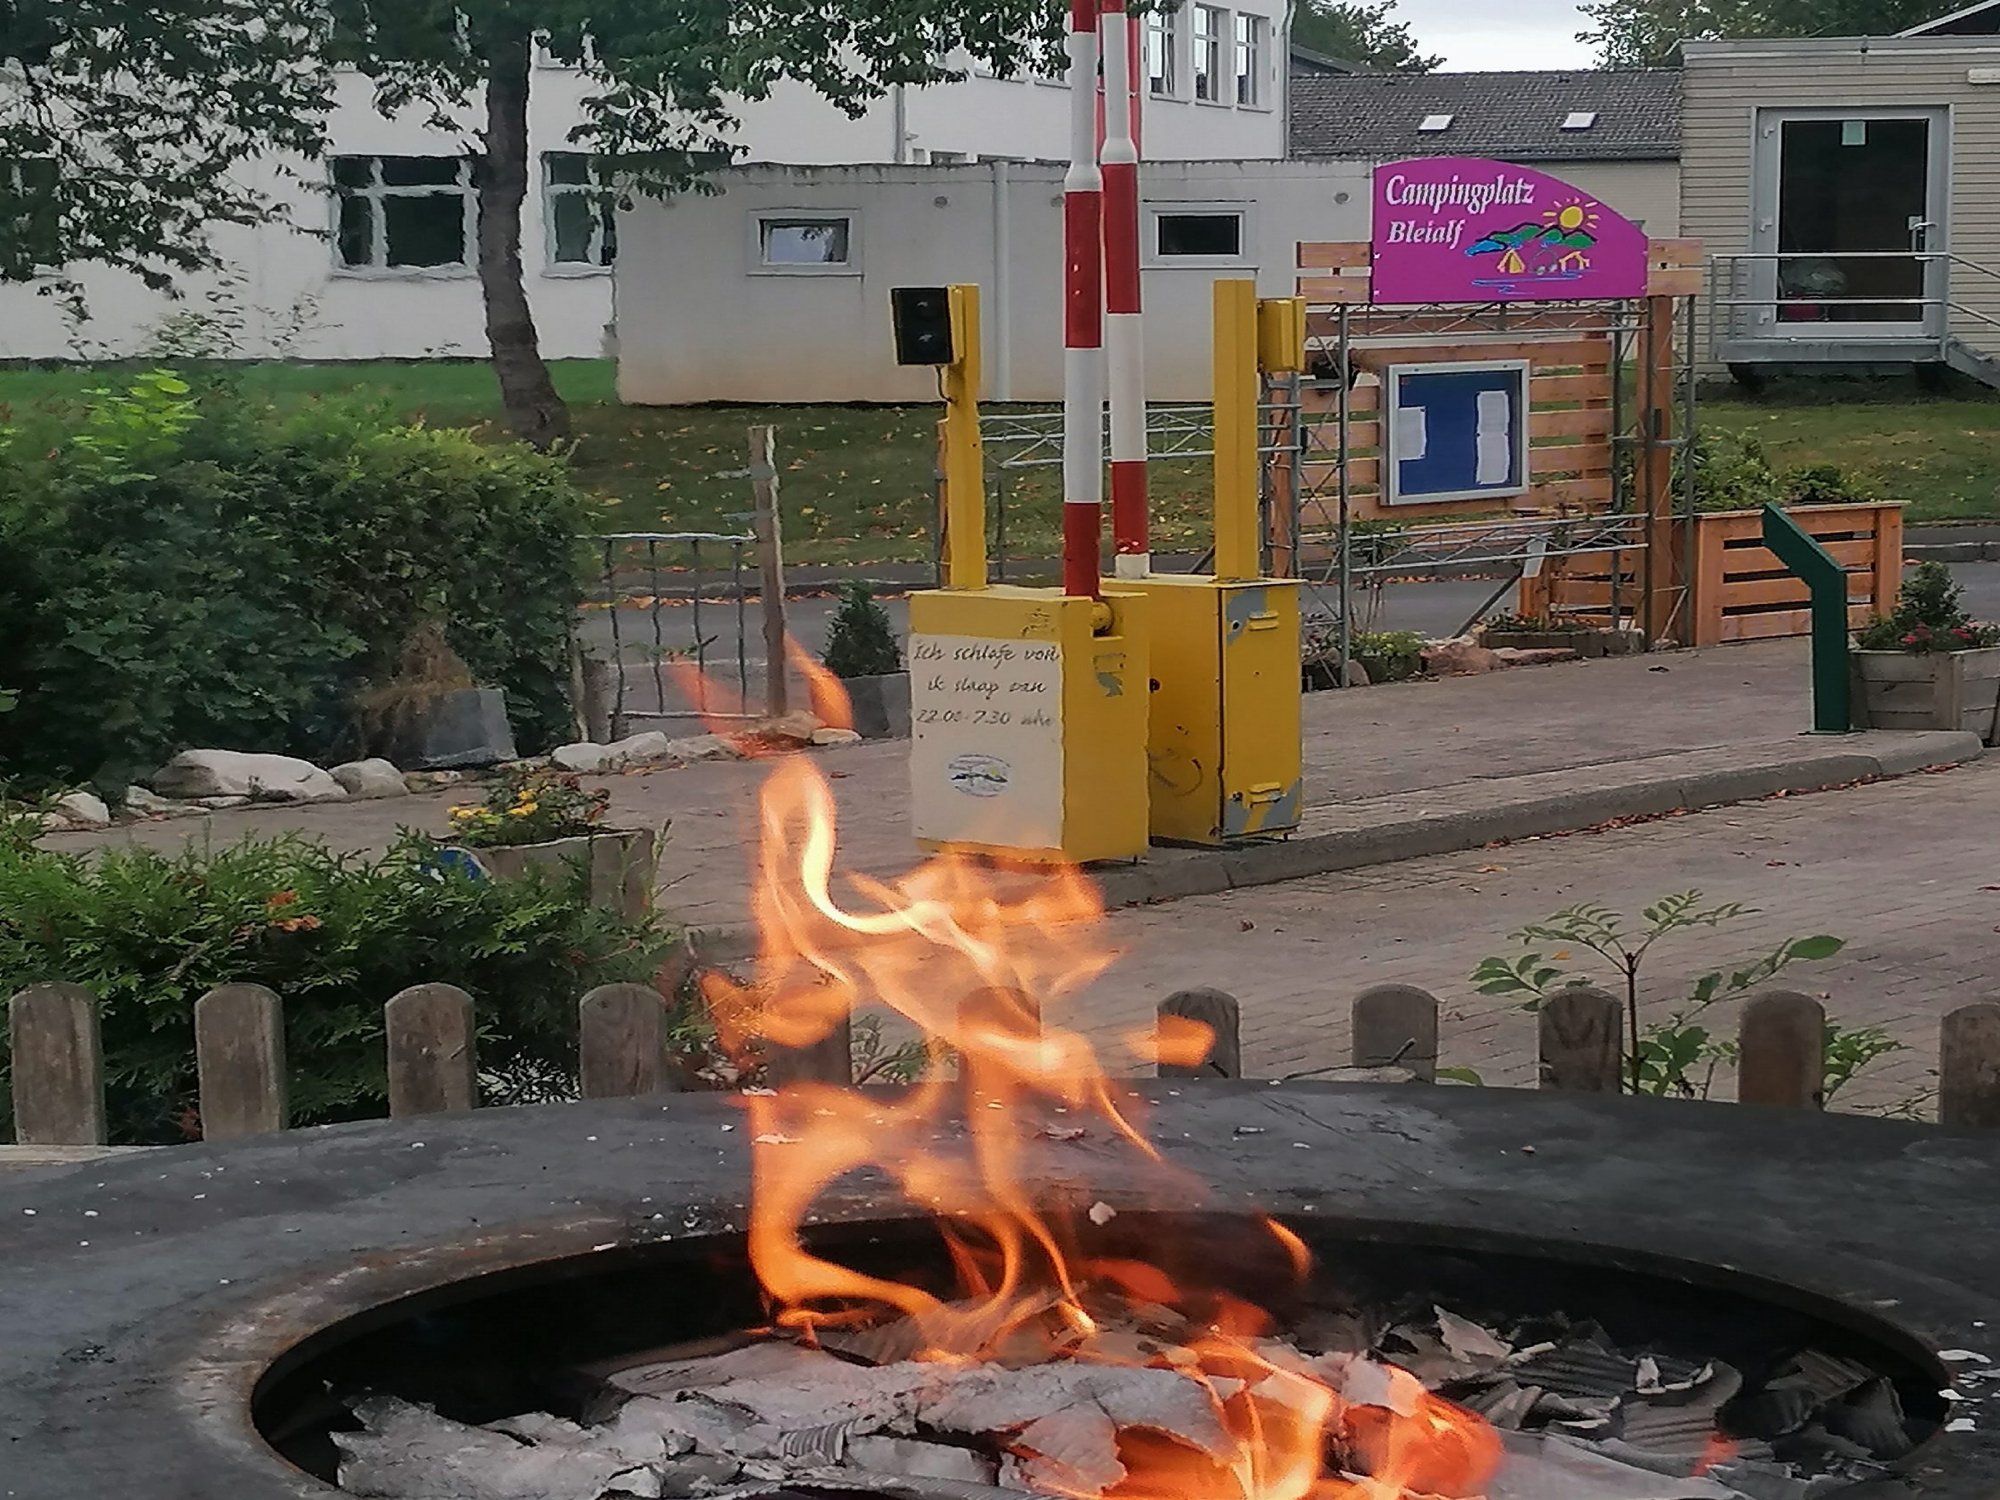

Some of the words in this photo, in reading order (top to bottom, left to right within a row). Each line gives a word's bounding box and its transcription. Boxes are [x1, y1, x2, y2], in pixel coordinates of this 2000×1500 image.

[1386, 174, 1536, 215] Campingplatz
[1387, 220, 1466, 249] Bleialf
[953, 642, 1016, 669] schlafe
